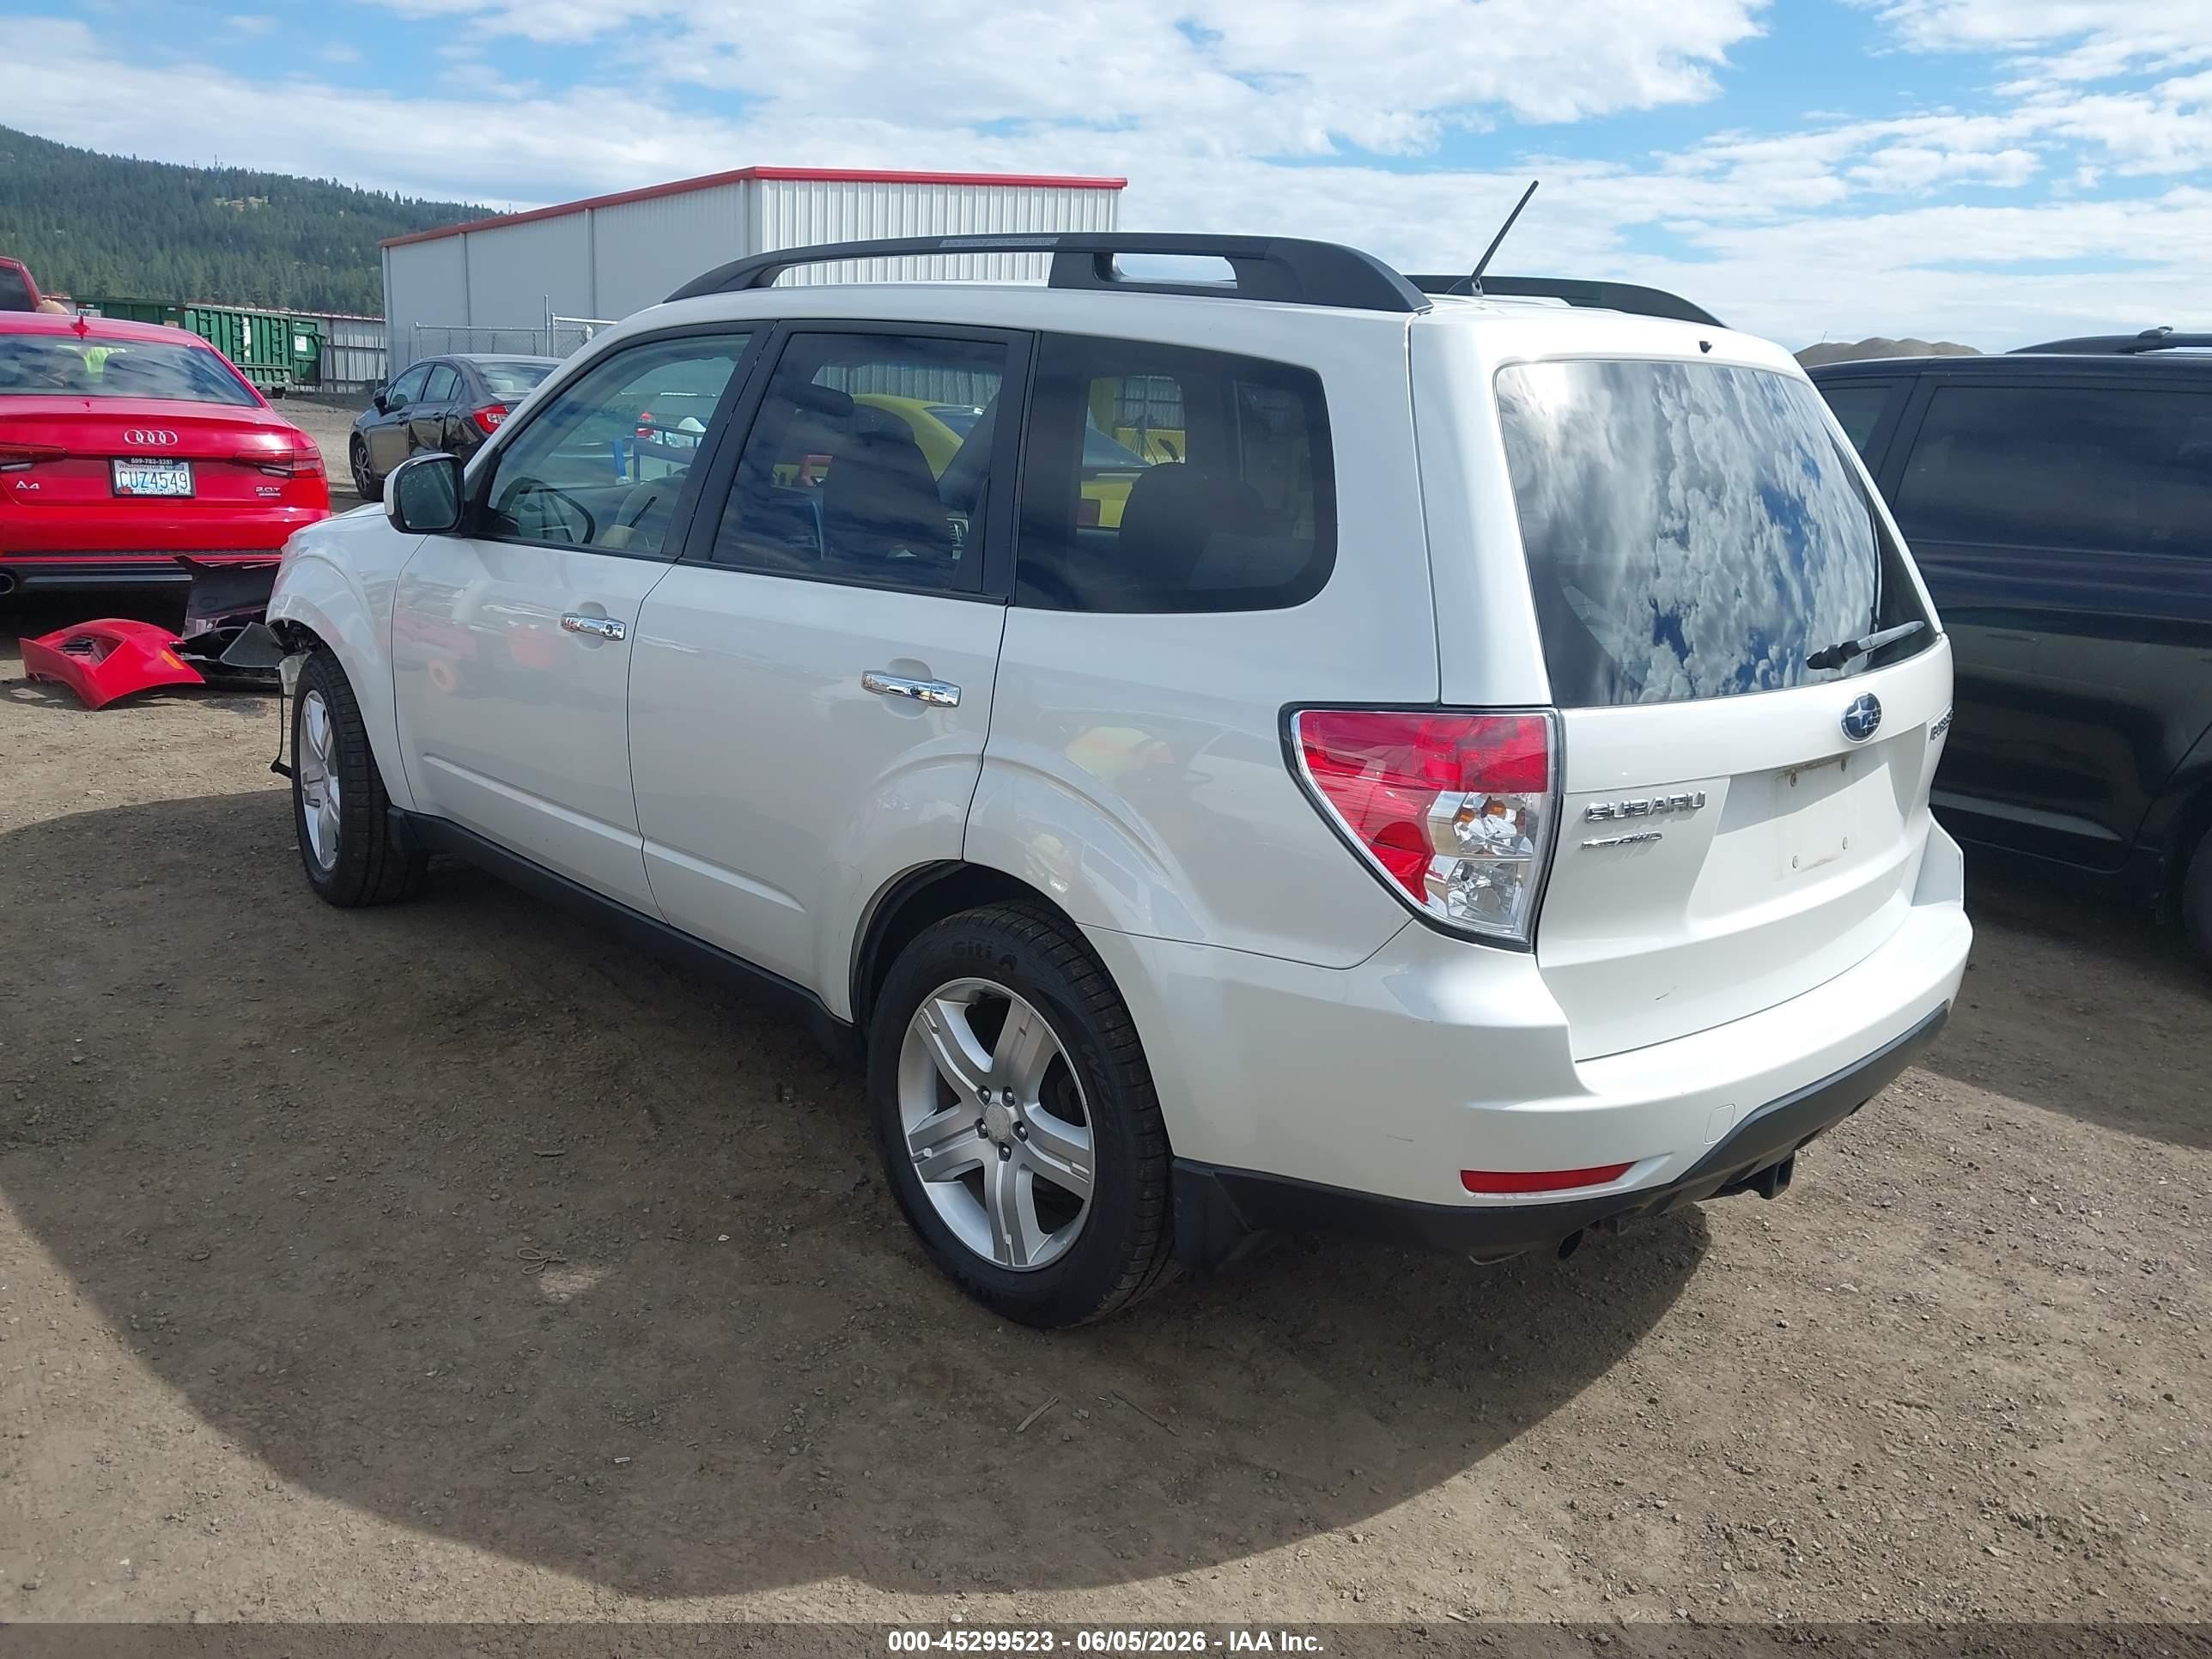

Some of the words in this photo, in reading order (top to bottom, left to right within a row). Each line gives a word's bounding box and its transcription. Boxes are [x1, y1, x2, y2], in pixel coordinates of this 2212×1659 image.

[15, 480, 40, 489] A4
[119, 471, 188, 490] CUZ4549
[1586, 790, 1705, 823] SUBARU
[951, 939, 994, 961] Giti
